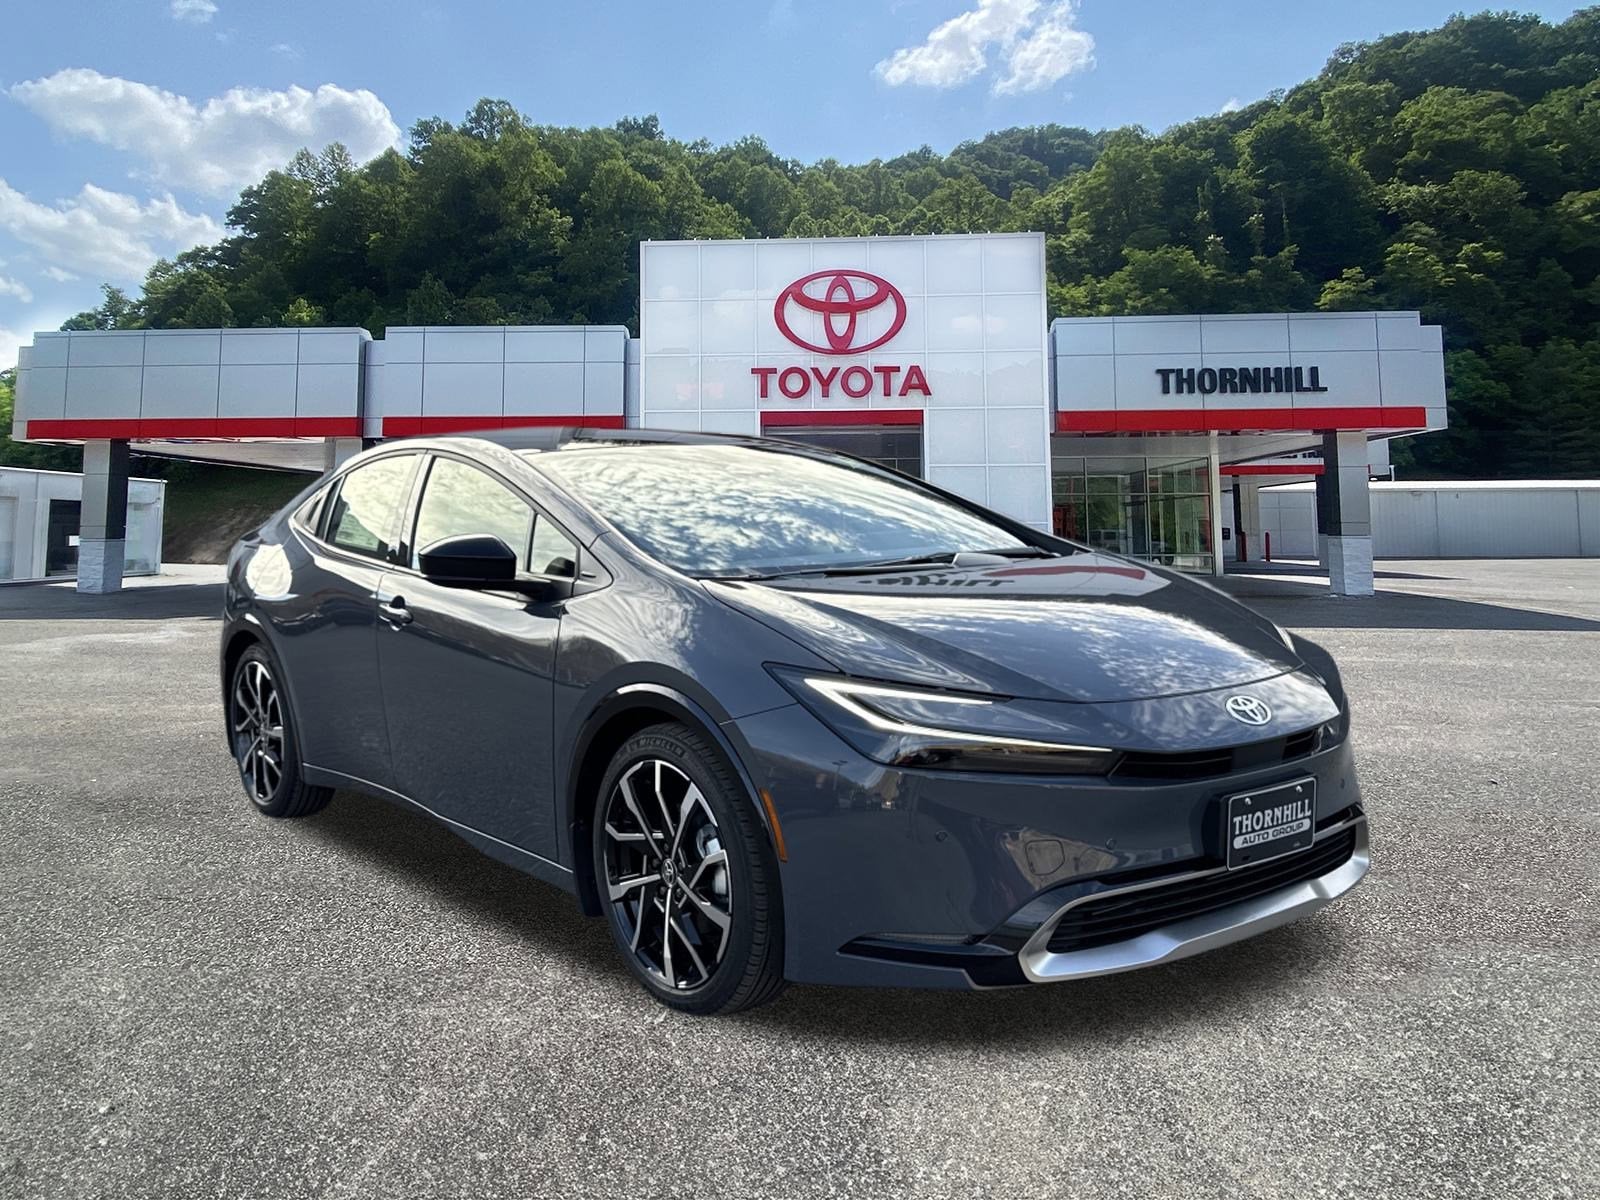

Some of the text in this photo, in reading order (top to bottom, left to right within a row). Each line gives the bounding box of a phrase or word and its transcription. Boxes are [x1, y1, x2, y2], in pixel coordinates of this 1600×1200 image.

[750, 365, 932, 399] TOYOTA
[1155, 366, 1328, 394] THORNHILL
[1233, 799, 1312, 835] THORNHILL
[1241, 822, 1304, 846] AUTO GROUP
